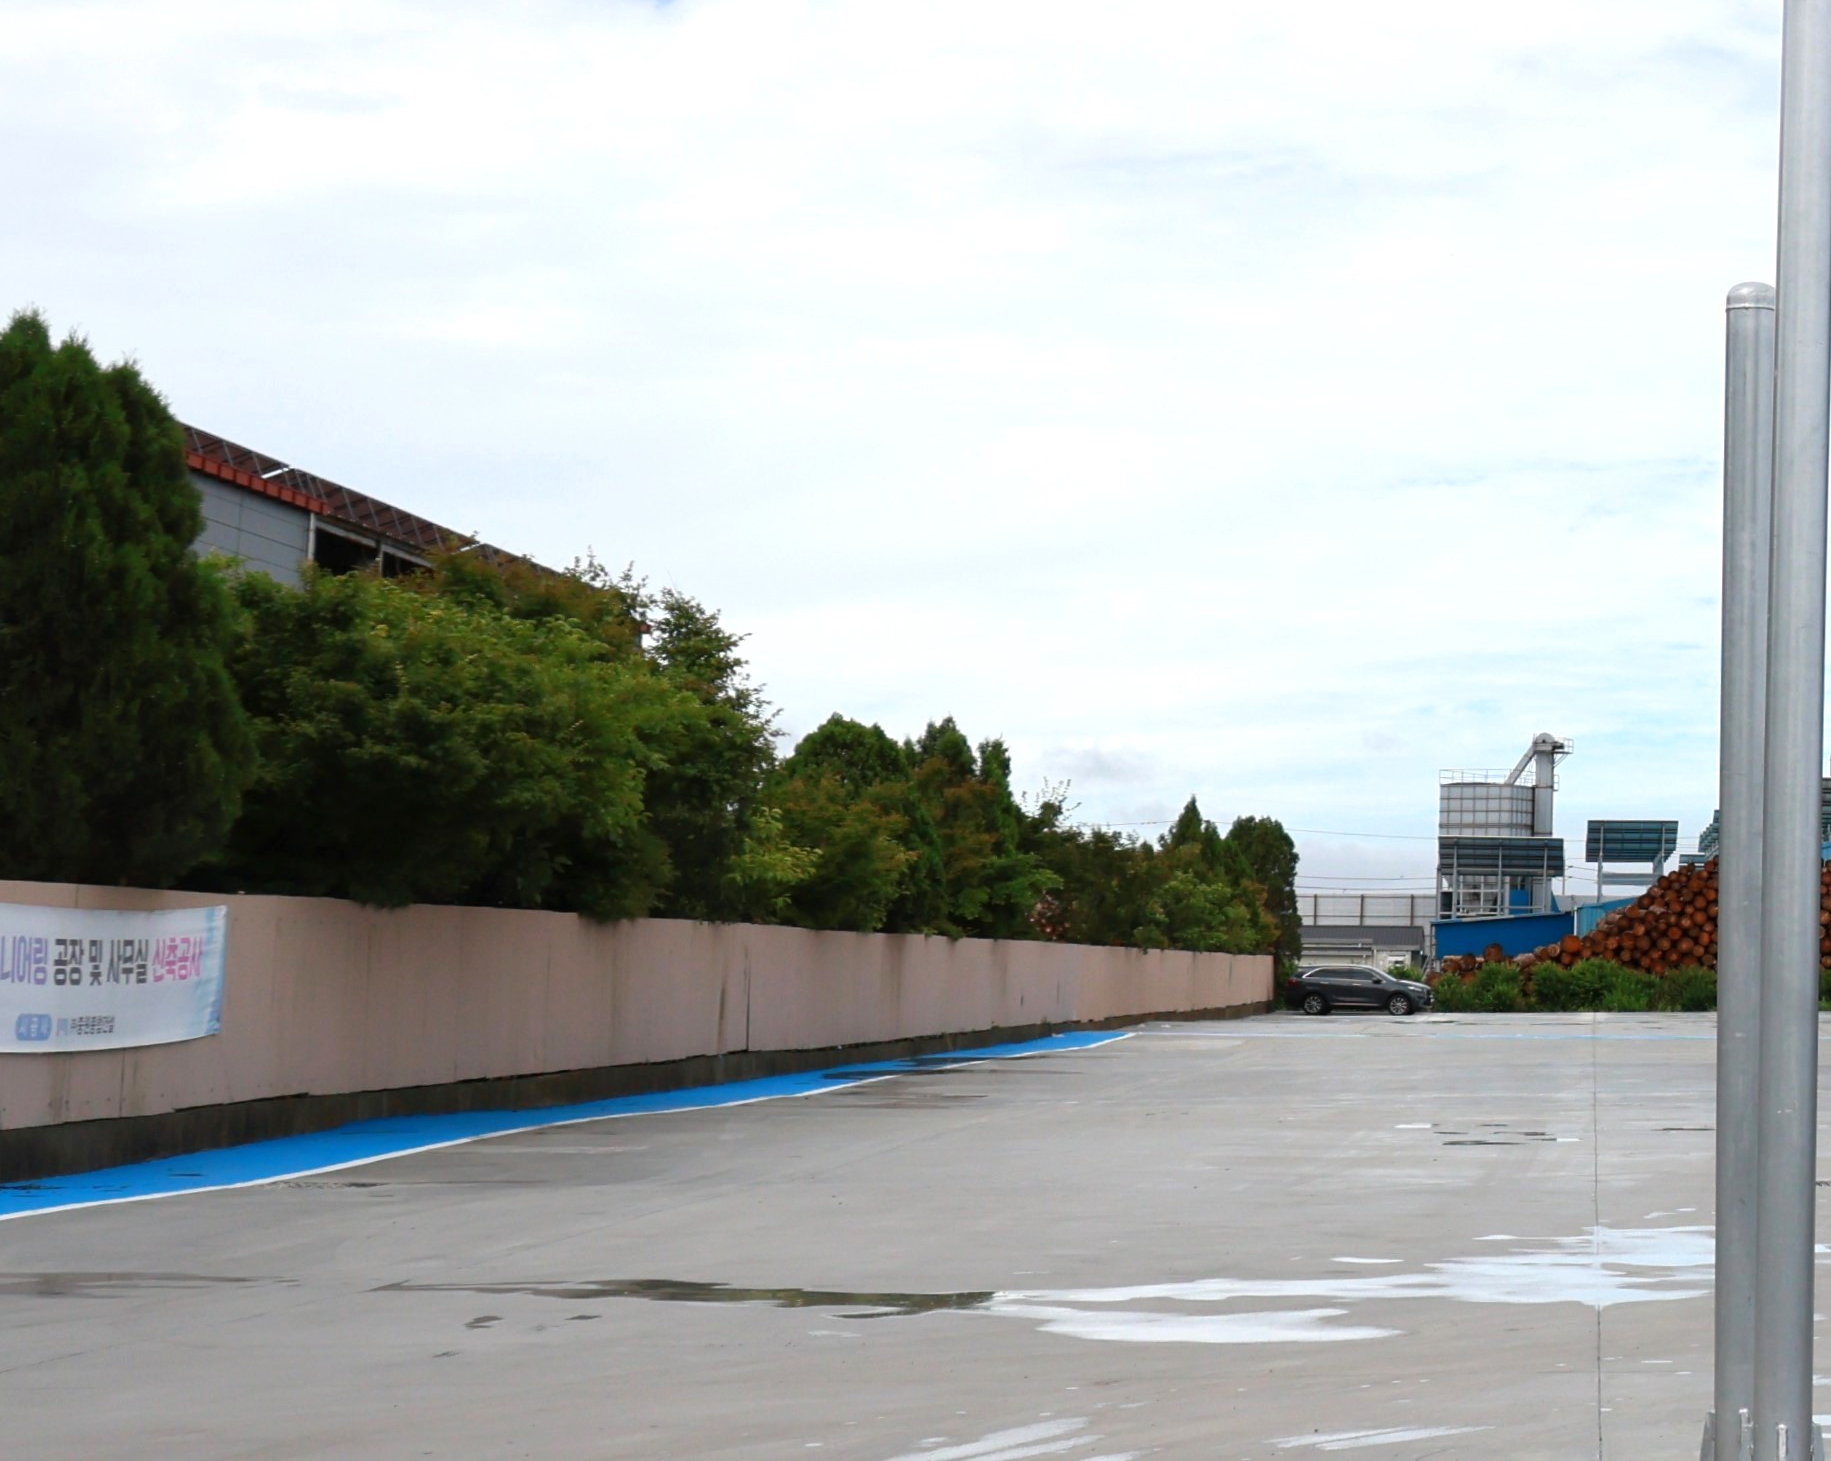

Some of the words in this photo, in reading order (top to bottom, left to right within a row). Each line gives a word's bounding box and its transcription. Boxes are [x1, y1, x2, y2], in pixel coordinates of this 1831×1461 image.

[53, 938, 84, 986] 공장
[88, 939, 102, 986] 및
[106, 939, 149, 984] 사무실
[152, 936, 203, 982] 신축공사
